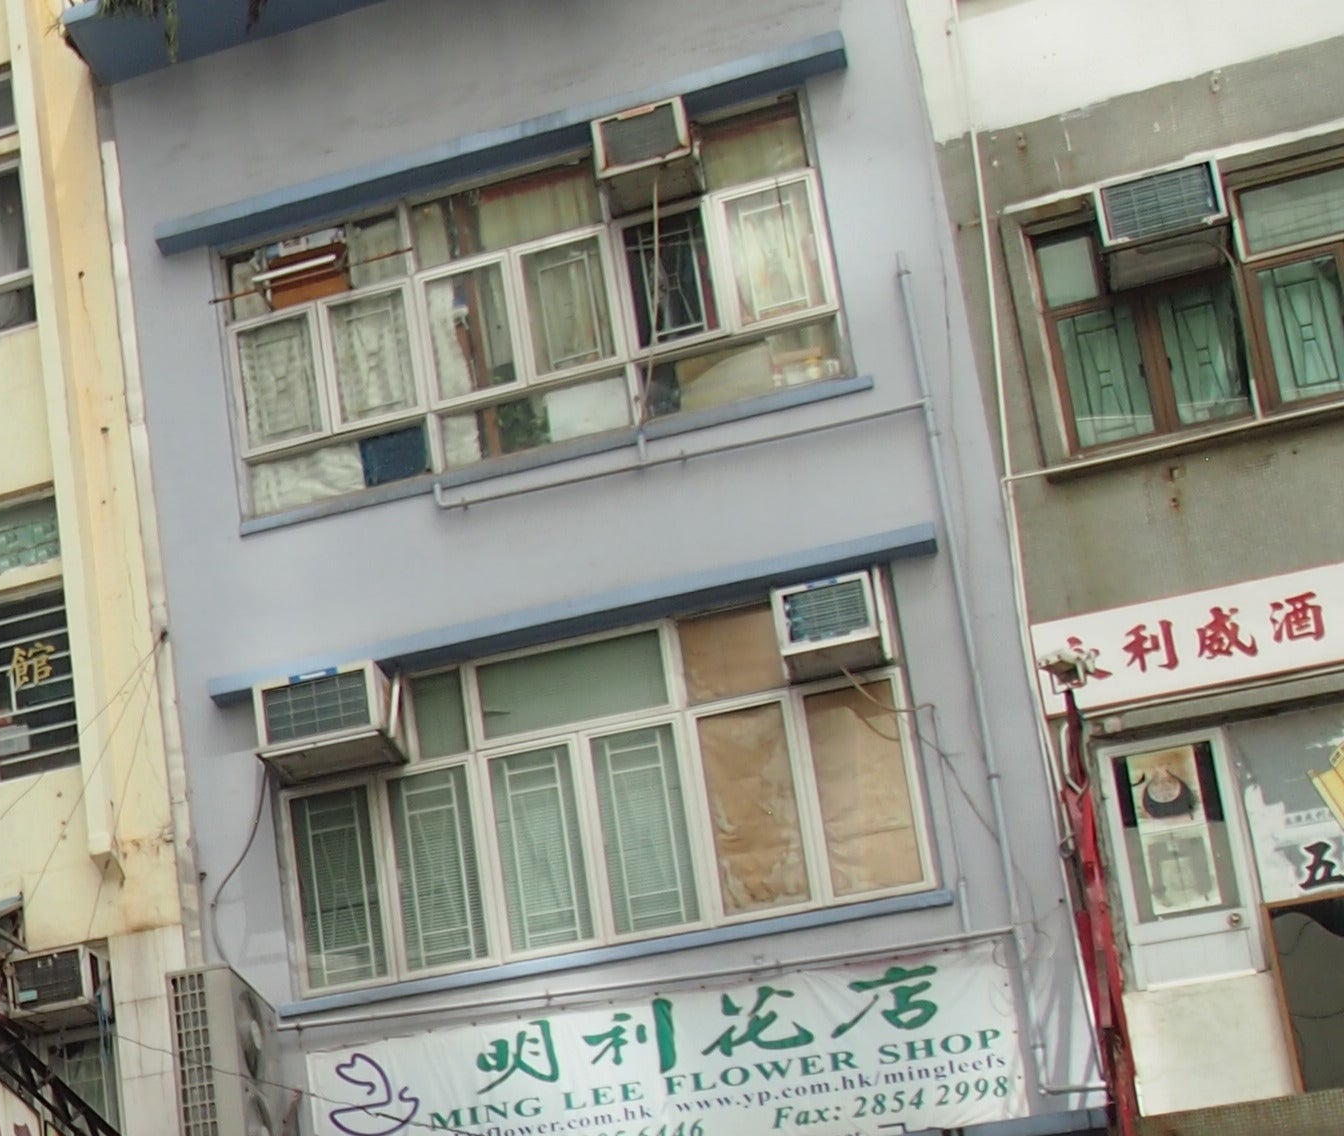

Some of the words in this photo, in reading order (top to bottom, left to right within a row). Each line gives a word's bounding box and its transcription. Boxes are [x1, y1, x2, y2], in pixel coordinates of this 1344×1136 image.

[428, 1096, 543, 1132] MING
[563, 1079, 643, 1112] LEE
[666, 1050, 860, 1097] FLOWER
[878, 1028, 1003, 1067] SHOP
[476, 964, 939, 1094] 明利花店
[771, 1099, 842, 1131] Fax:
[854, 1087, 925, 1120] 2854
[934, 1074, 1010, 1108] 2998
